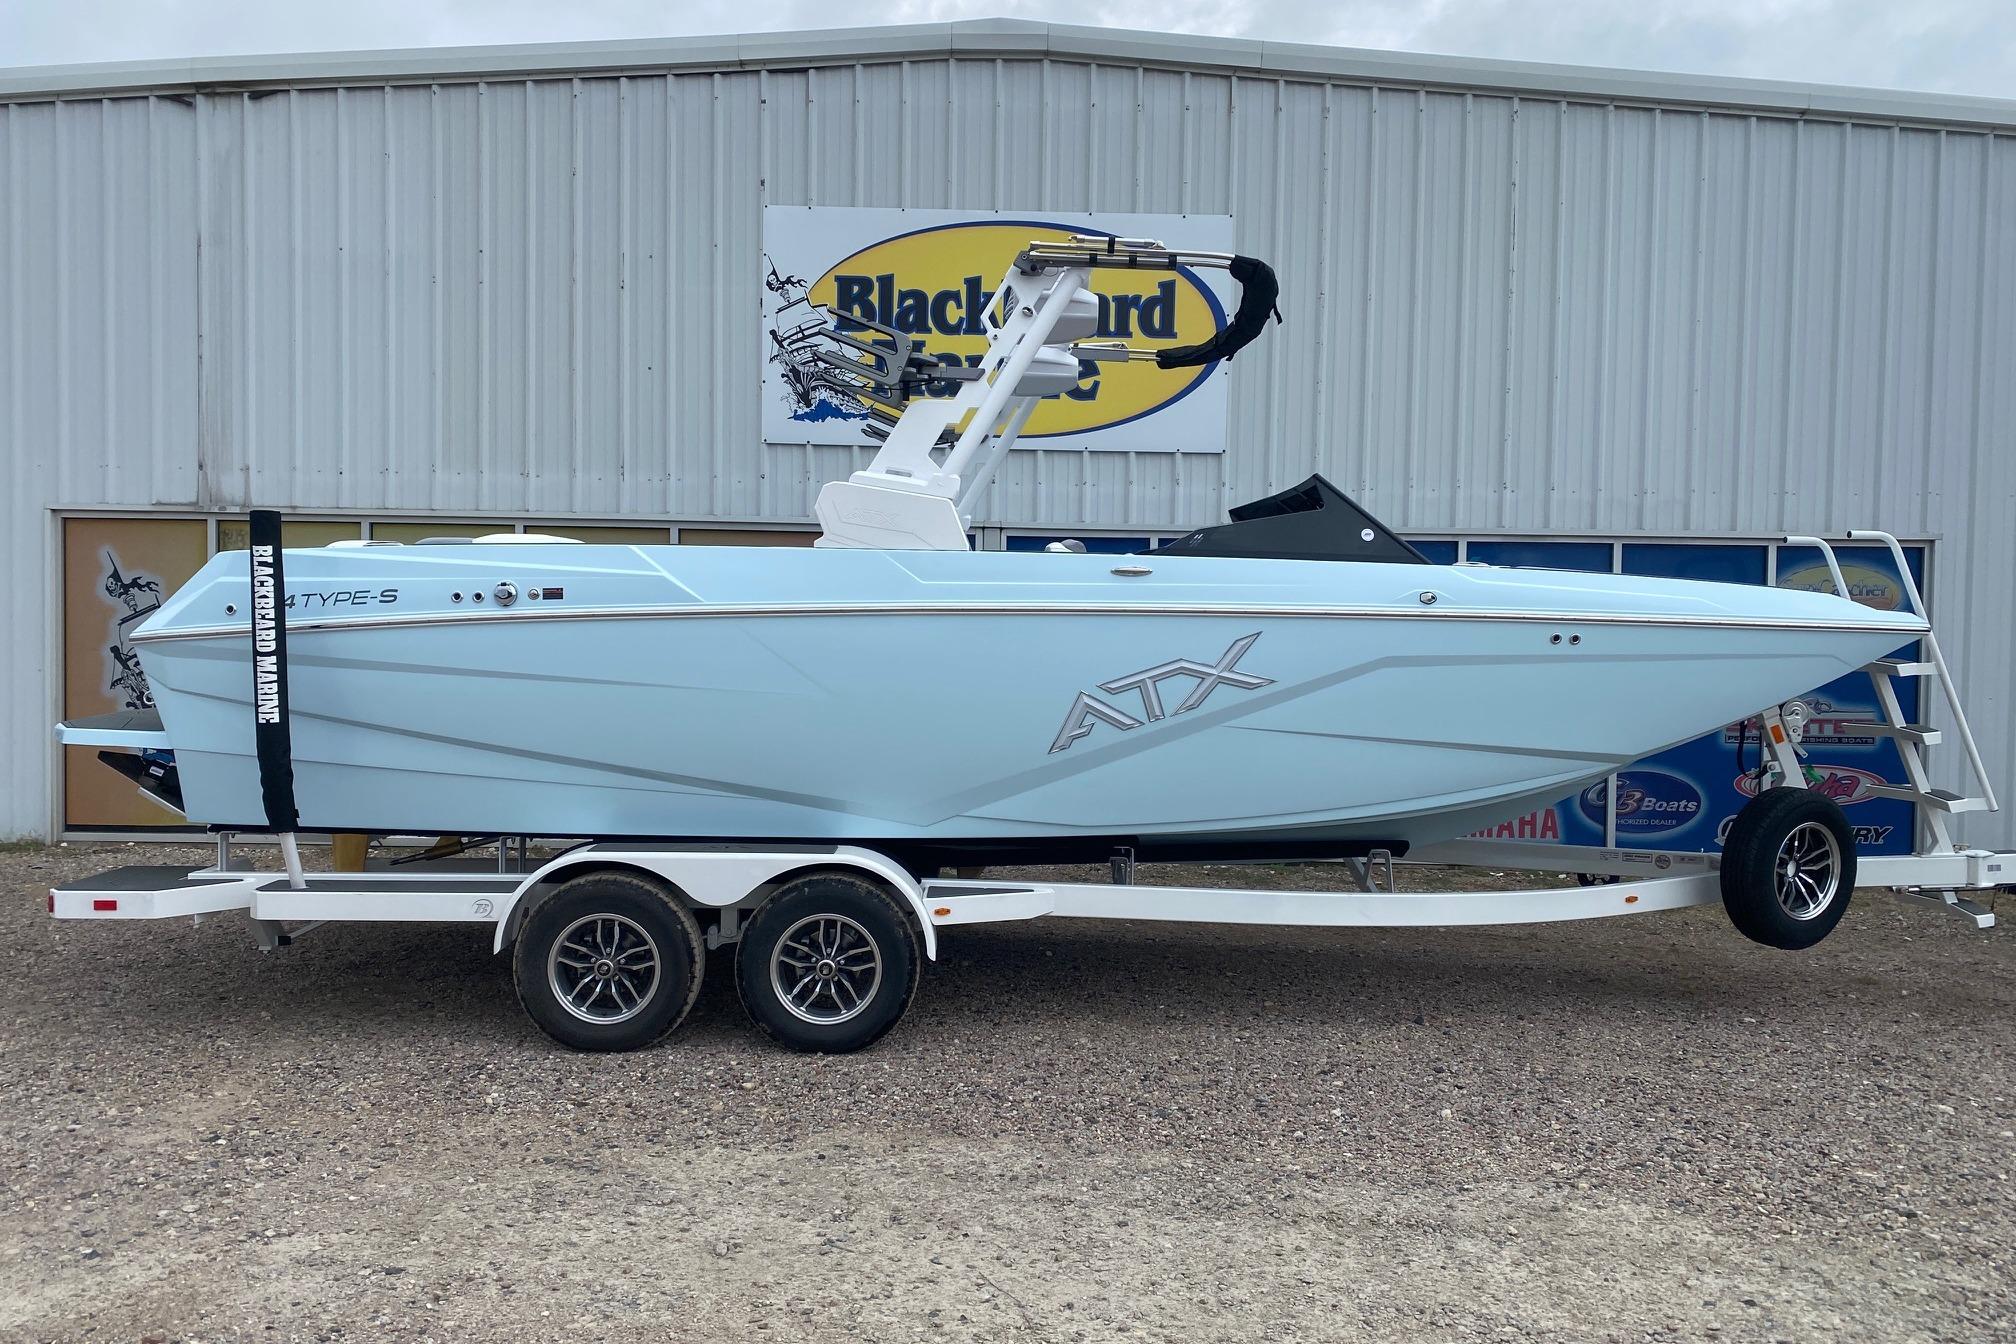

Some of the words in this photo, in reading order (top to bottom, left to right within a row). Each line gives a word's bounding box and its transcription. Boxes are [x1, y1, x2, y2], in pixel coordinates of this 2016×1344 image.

[833, 273, 1178, 340] Blackard
[252, 545, 277, 653] BLACKBEARD
[301, 588, 399, 608] TYPE-S
[256, 655, 280, 724] MARINE
[1047, 630, 1279, 756] ATX
[1616, 818, 1649, 826] HORIZED
[1640, 797, 1699, 813] Boats
